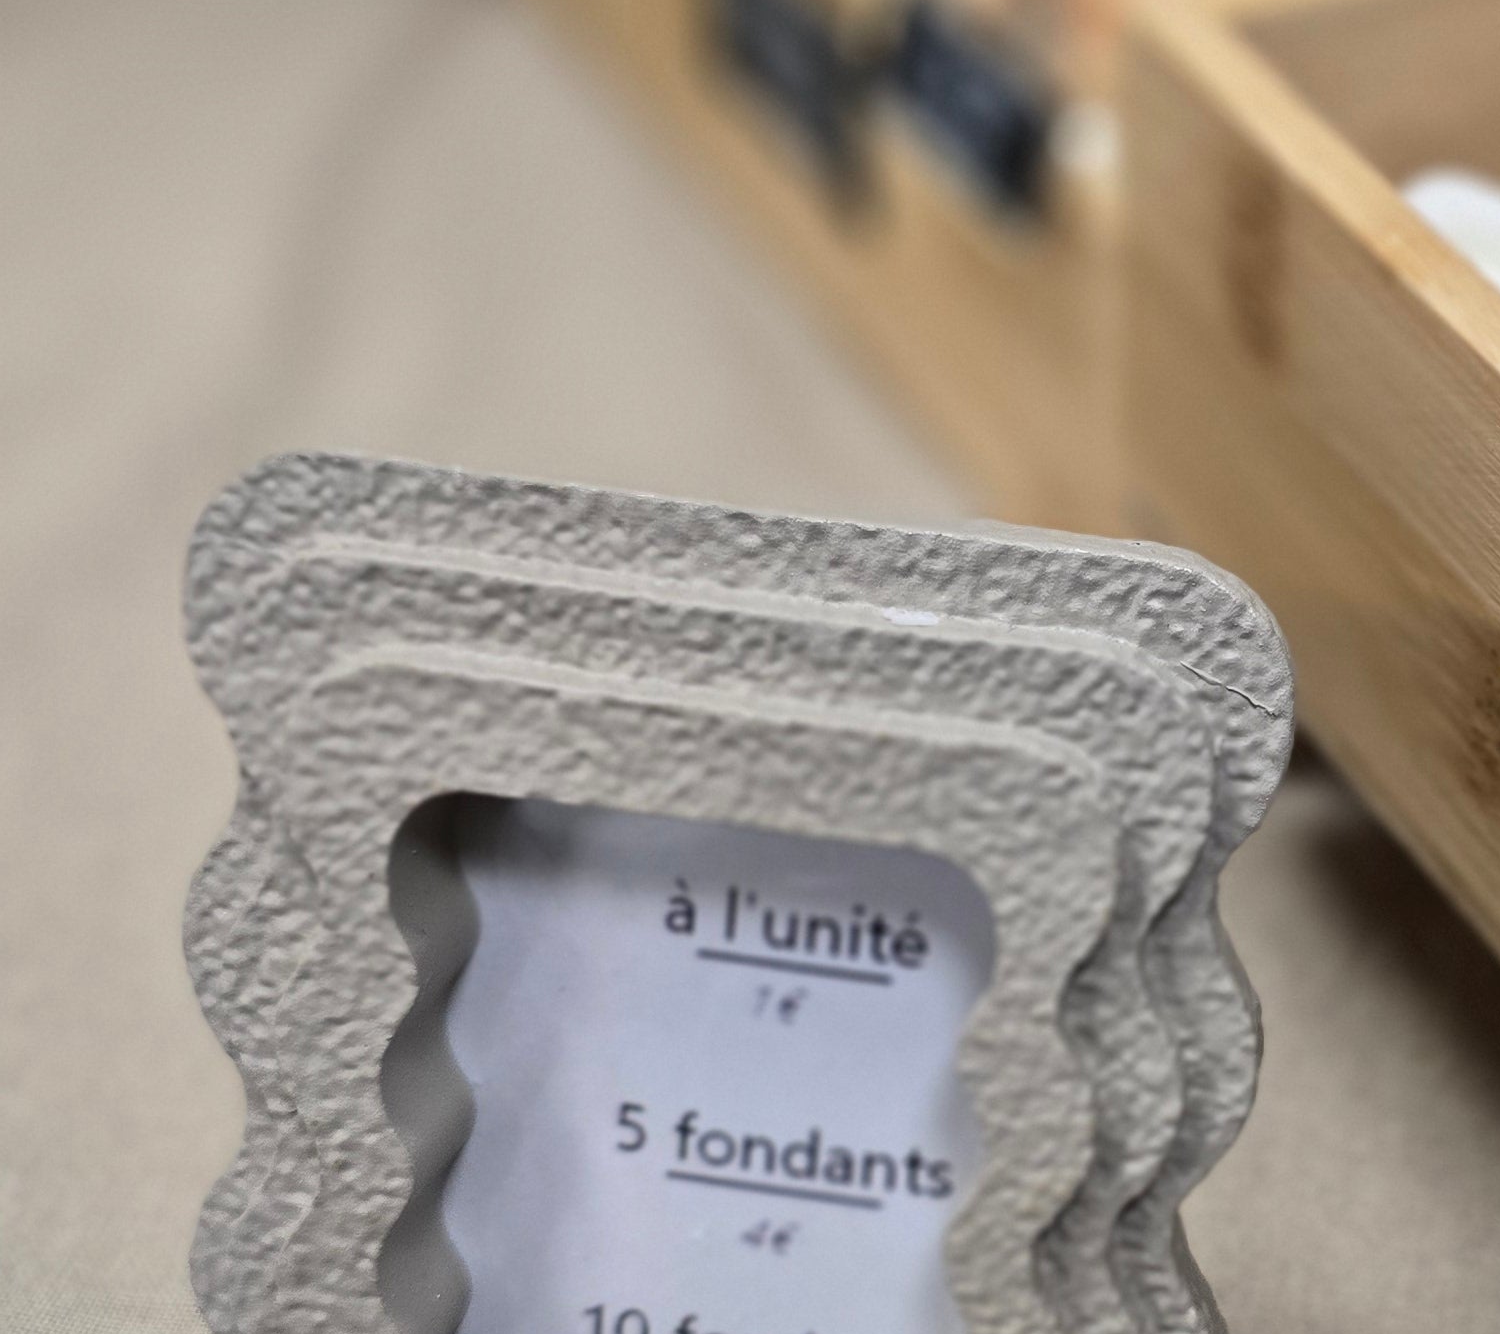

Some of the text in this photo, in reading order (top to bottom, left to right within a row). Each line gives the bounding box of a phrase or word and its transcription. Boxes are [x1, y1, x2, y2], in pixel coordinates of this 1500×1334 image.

[664, 877, 929, 968] à l'unité
[616, 1102, 954, 1199] 5 fondants
